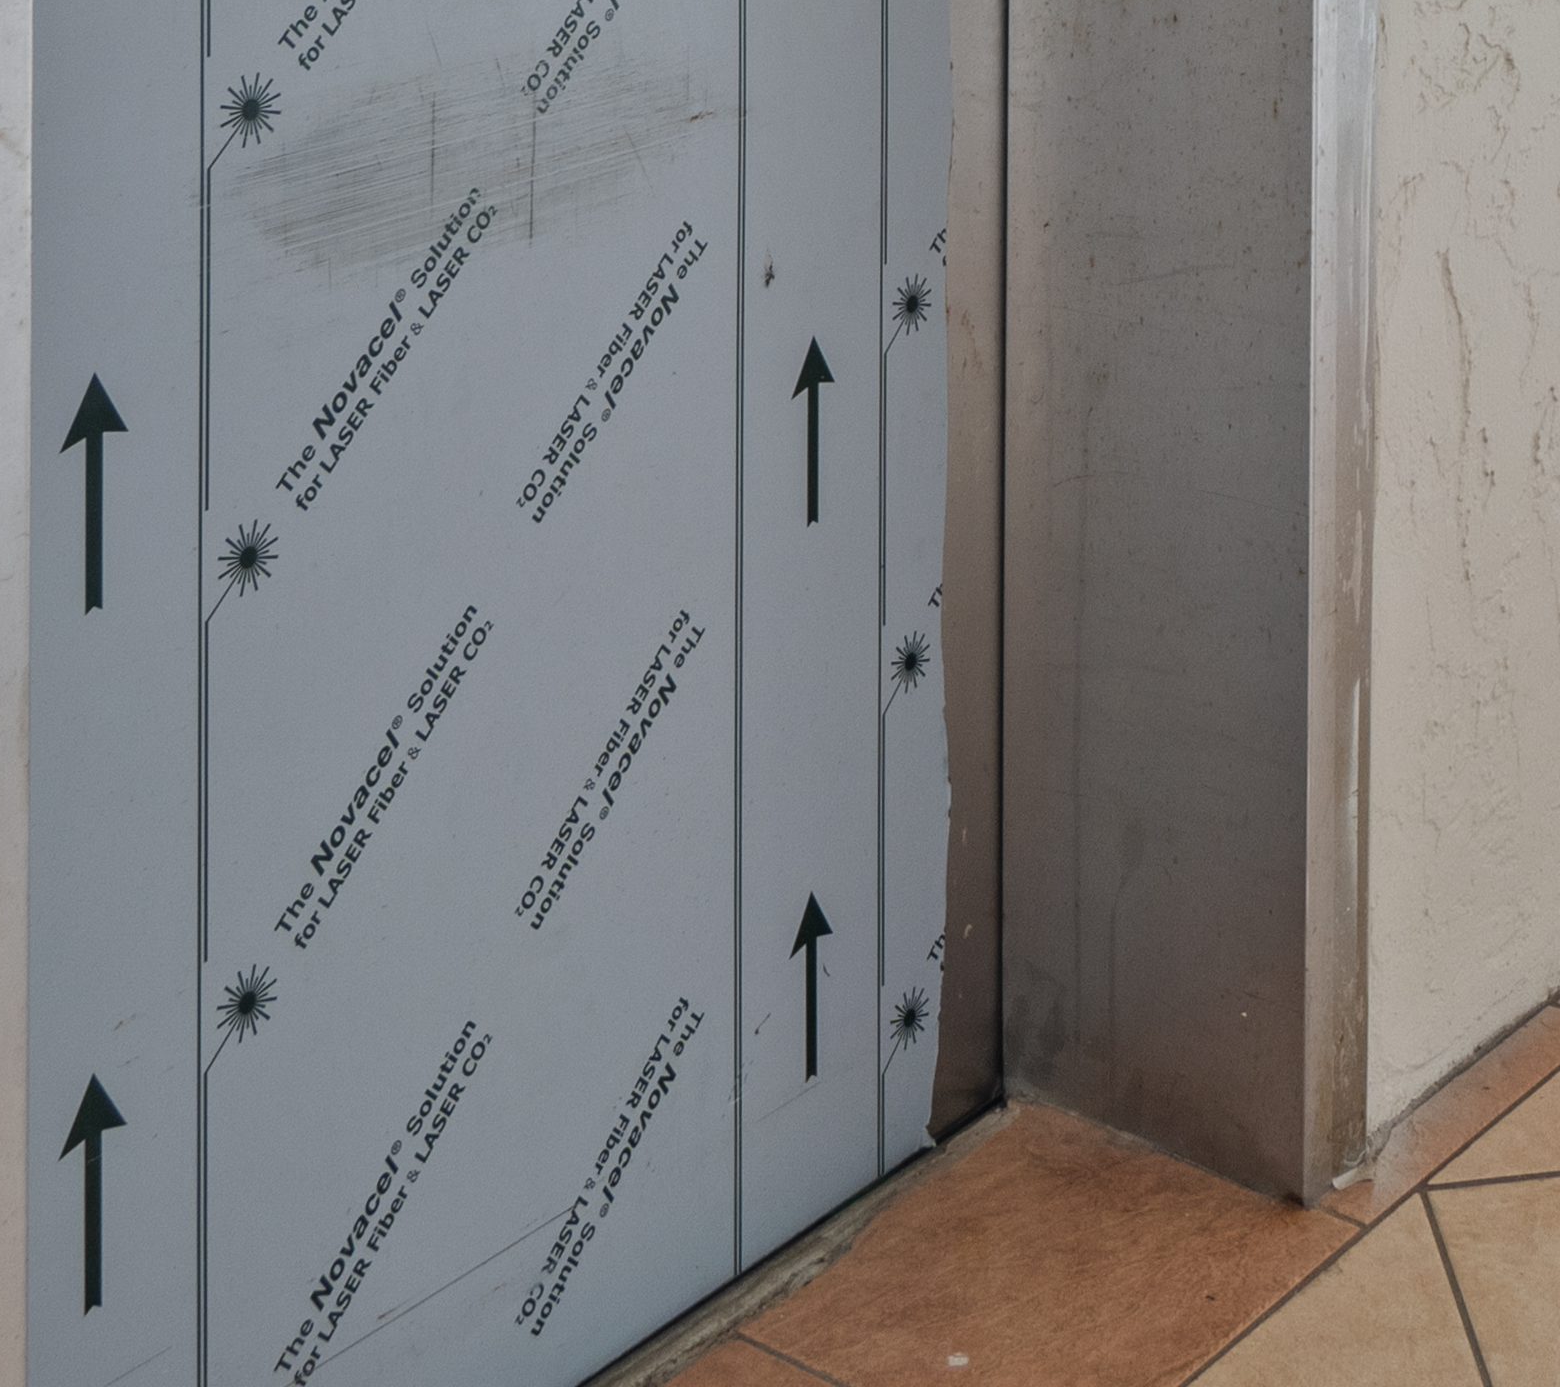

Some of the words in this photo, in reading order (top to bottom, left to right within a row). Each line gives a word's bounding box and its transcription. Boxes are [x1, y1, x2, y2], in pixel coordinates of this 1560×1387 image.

[277, 4, 319, 50] The
[297, 34, 326, 71] for
[671, 220, 693, 254] for
[676, 239, 709, 280] The
[628, 252, 675, 321] LASER
[596, 322, 634, 379] Fiber
[541, 393, 591, 466] LASER
[531, 422, 598, 524] Solution
[668, 609, 691, 644] for
[673, 626, 706, 669] The
[414, 665, 468, 743] LASER
[625, 643, 672, 716] LASER
[273, 882, 315, 932] The
[406, 604, 478, 714] Solution
[407, 746, 422, 761] &
[594, 718, 631, 778] Fiber
[366, 760, 409, 825] Fiber
[540, 795, 589, 871] LASER
[317, 828, 373, 909] LASER
[530, 822, 596, 931] Solution
[293, 909, 321, 950] for
